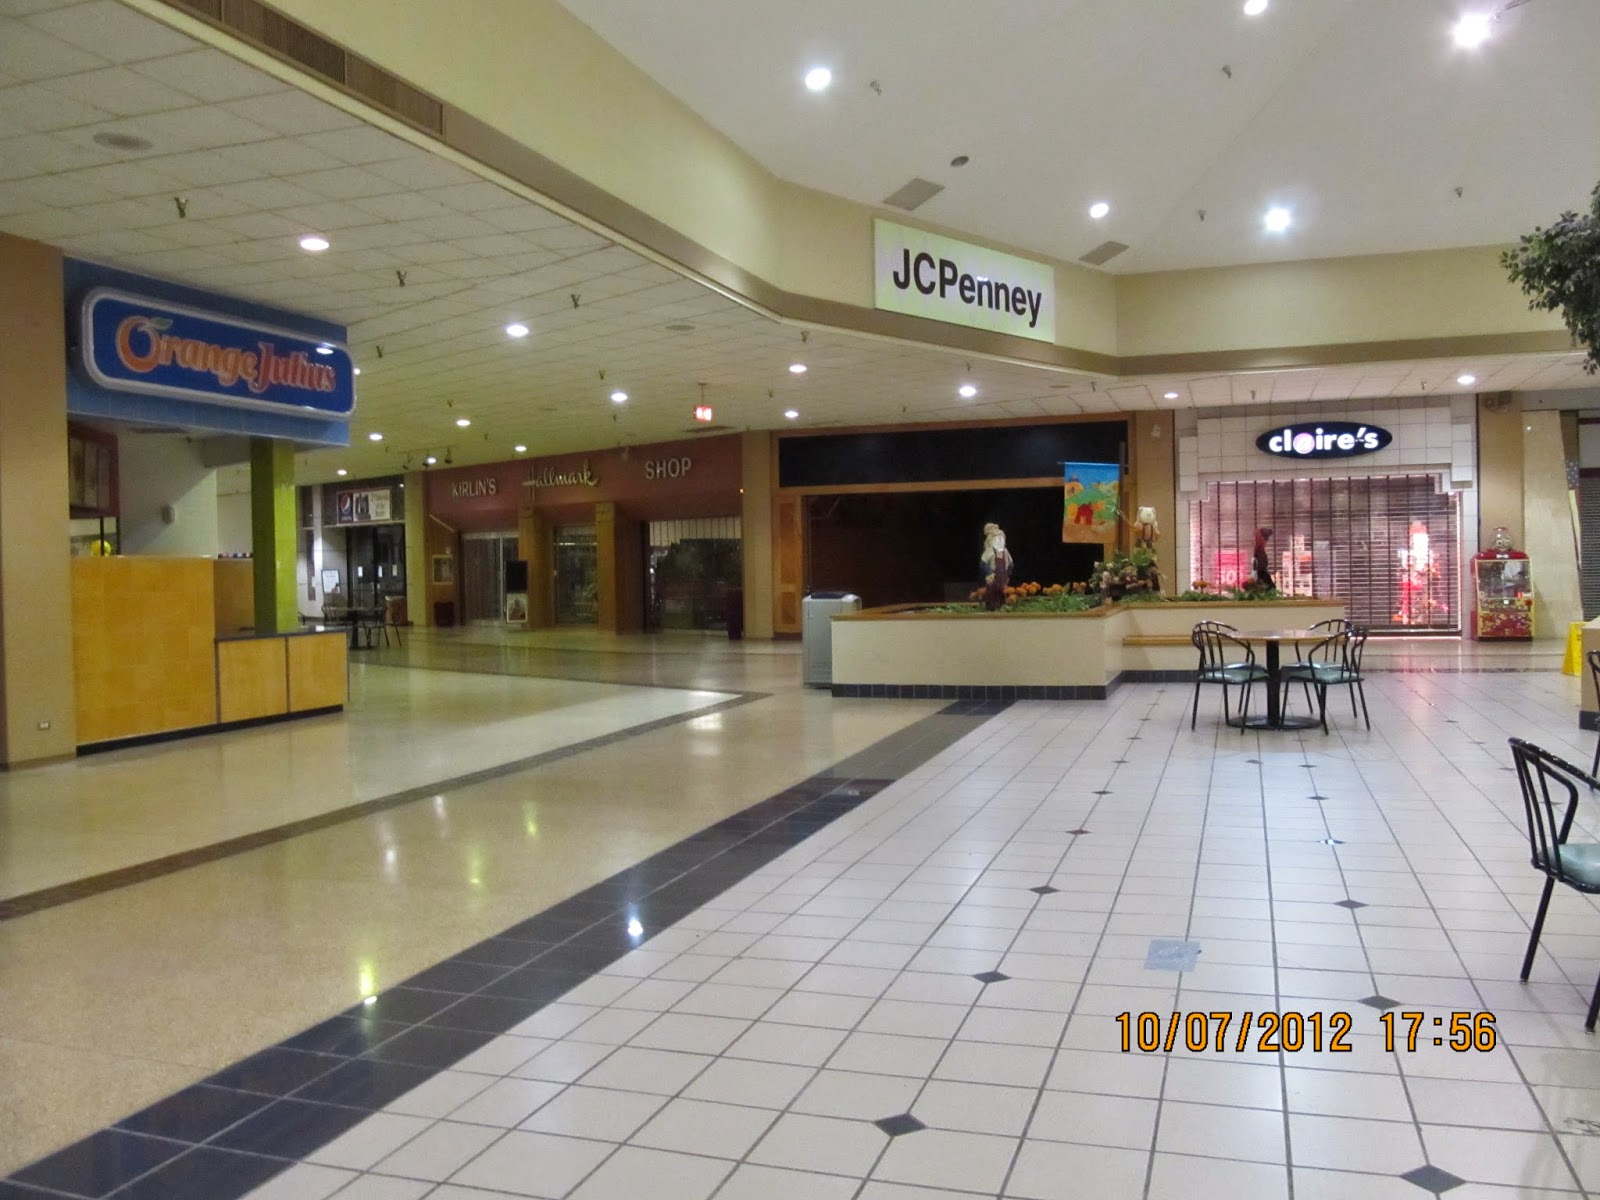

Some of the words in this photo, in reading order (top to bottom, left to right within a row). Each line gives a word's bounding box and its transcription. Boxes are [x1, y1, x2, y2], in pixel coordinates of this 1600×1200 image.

[893, 248, 1042, 328] JCPenney
[115, 316, 258, 386] Orange
[248, 341, 336, 393] Julius
[1269, 427, 1379, 454] claire's
[452, 478, 497, 497] KIRLIN'S
[521, 459, 598, 501] Hallmark
[645, 457, 691, 479] SHOP
